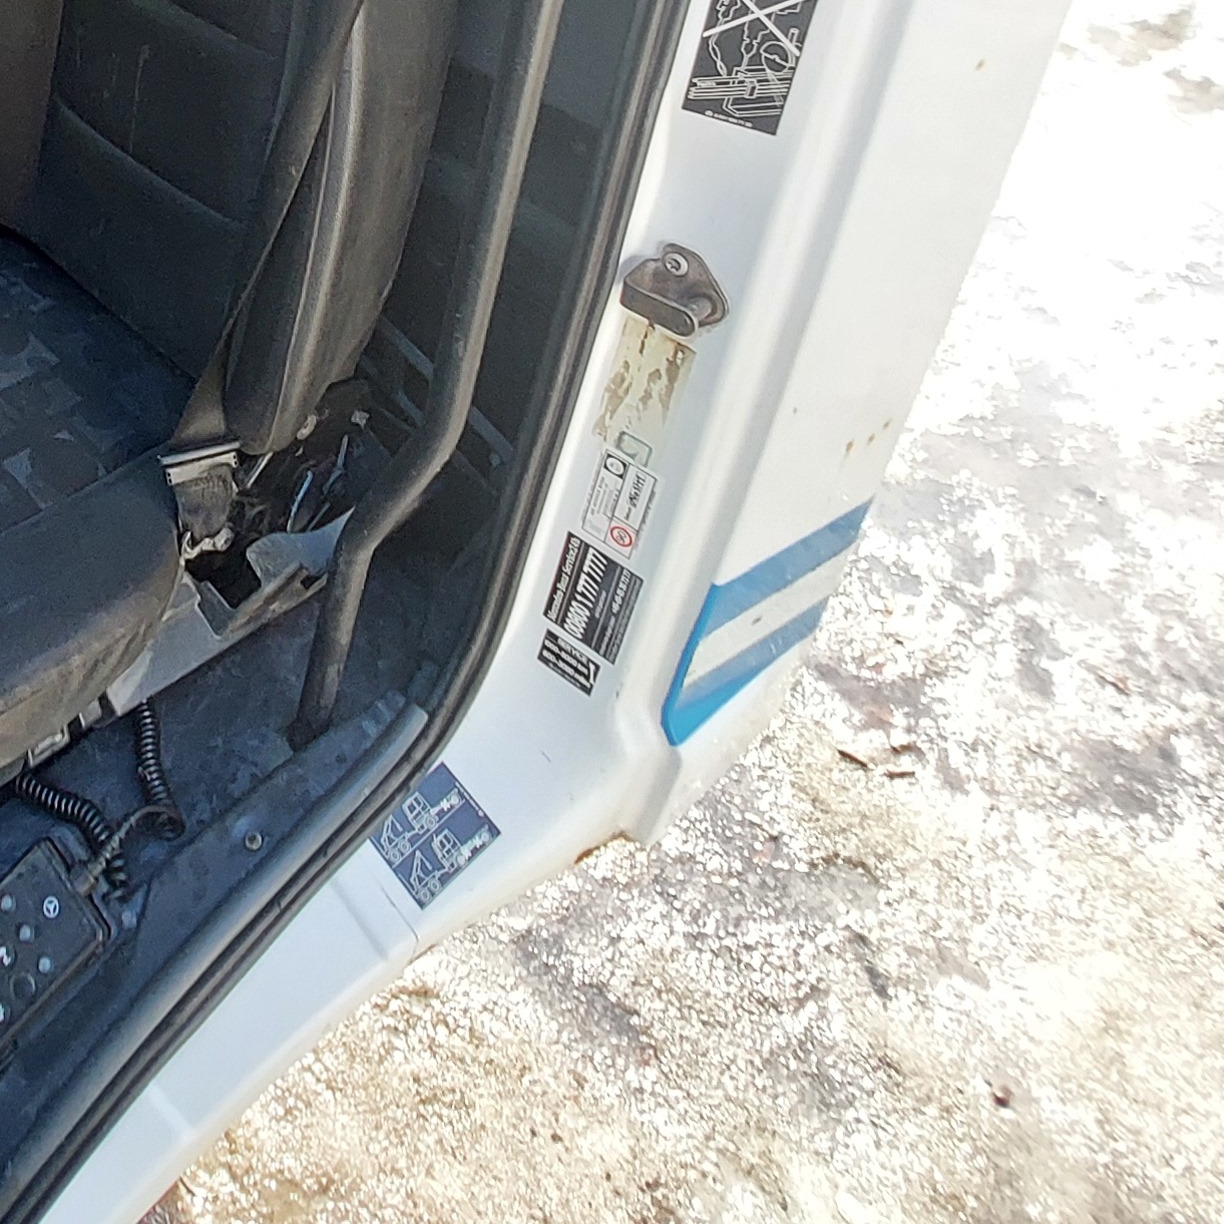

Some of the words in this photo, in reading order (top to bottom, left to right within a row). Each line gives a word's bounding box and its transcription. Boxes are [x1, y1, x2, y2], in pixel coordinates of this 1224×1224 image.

[581, 545, 609, 583] 7777
[572, 591, 594, 609] 1
[575, 571, 600, 603] 777
[562, 598, 591, 640] 00800
